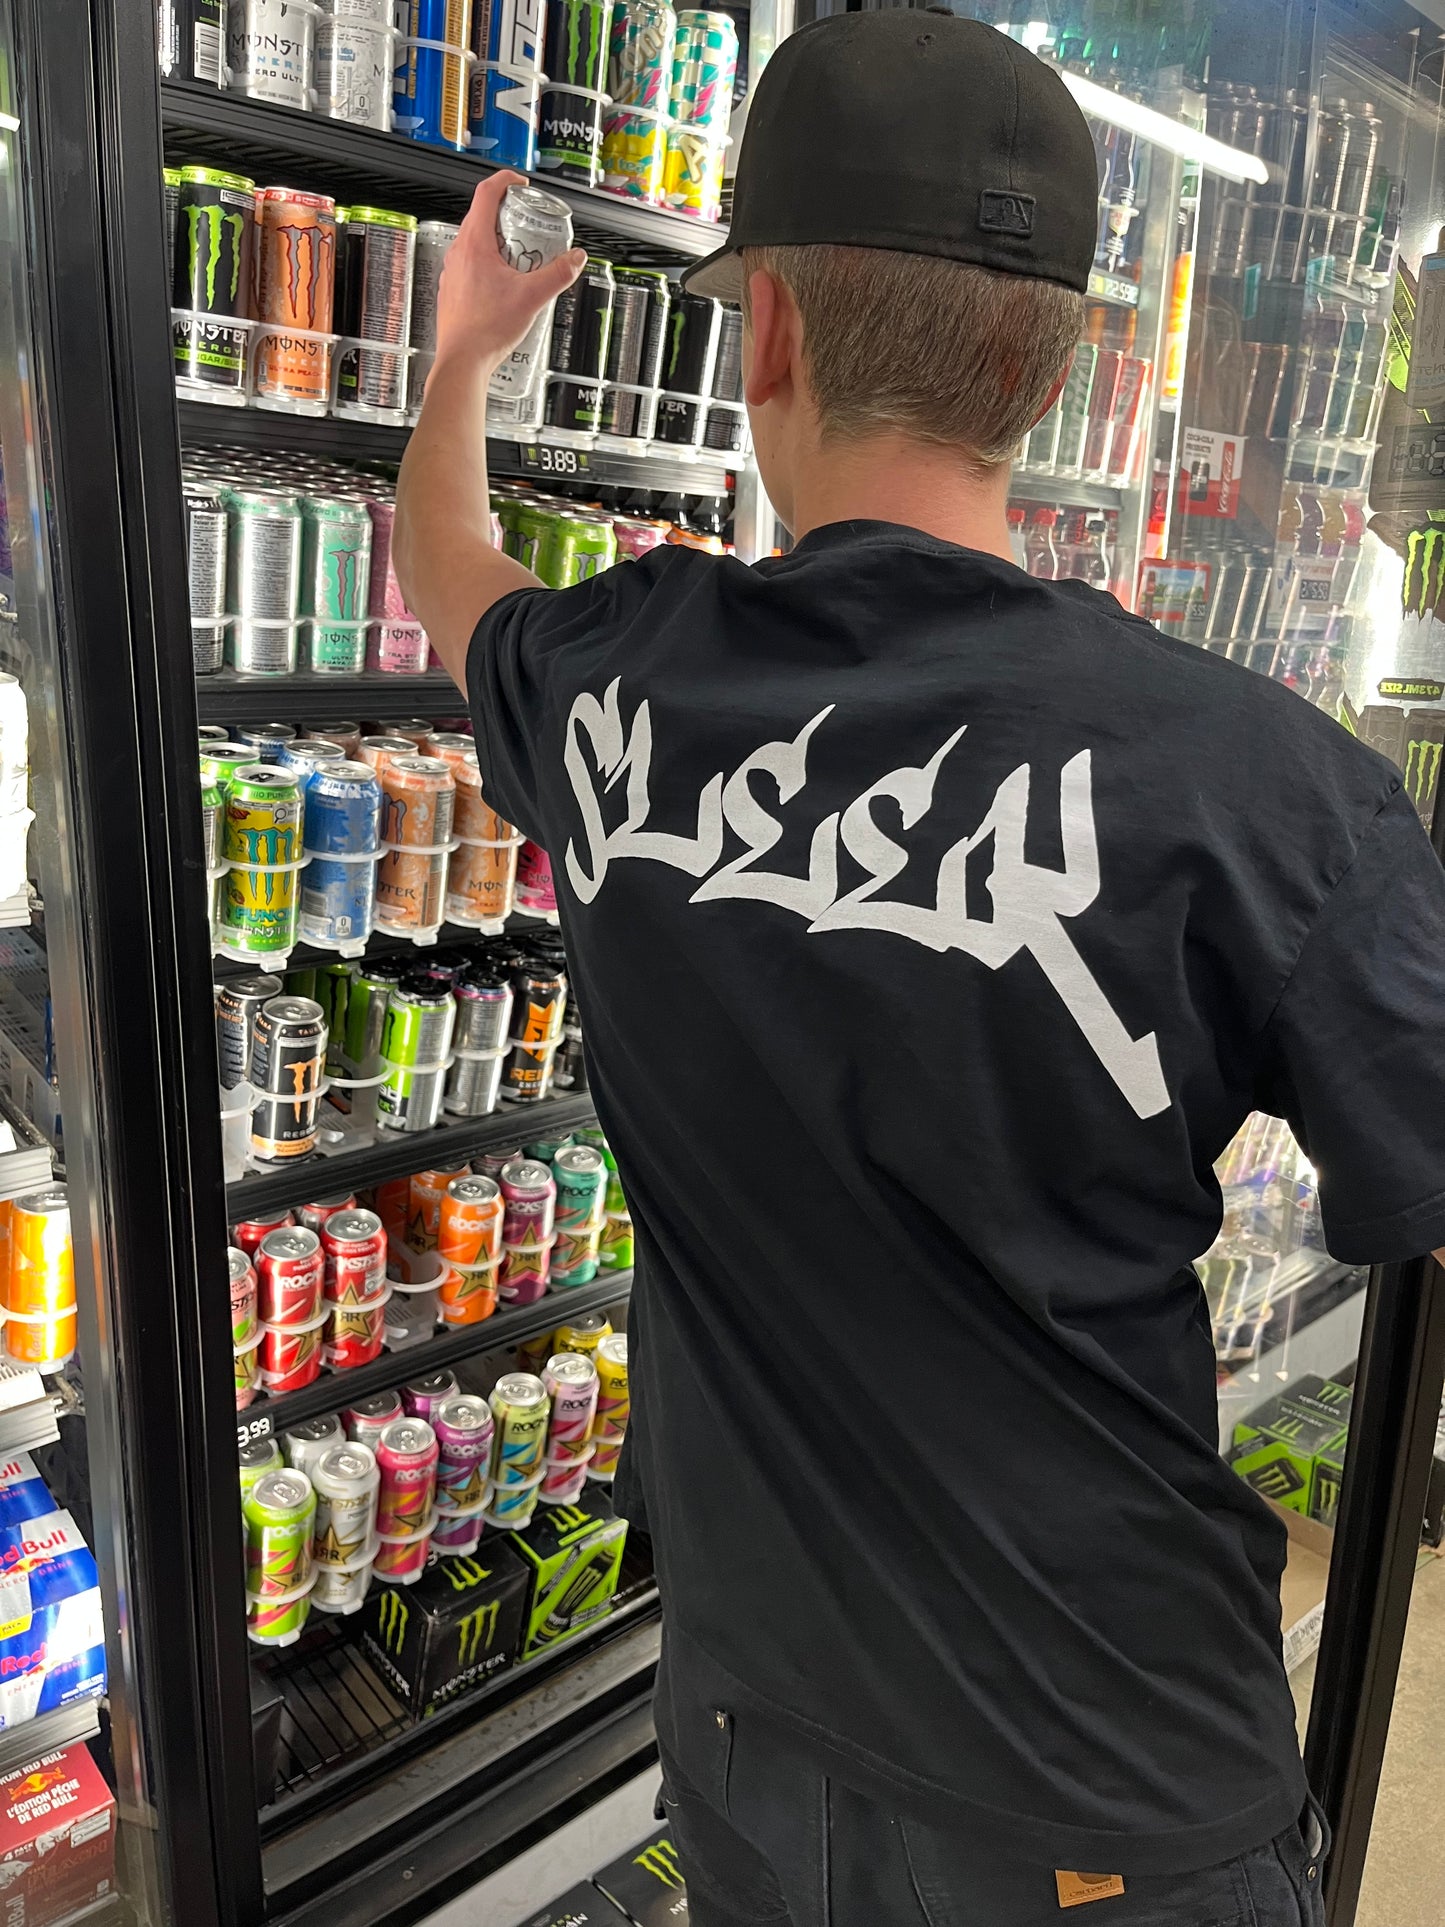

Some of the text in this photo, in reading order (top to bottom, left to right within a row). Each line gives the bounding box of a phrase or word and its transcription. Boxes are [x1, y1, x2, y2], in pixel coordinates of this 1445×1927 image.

[232, 32, 306, 57] MONST
[543, 118, 604, 146] MONS
[540, 447, 578, 474] 3.89
[237, 1416, 271, 1449] 3.99
[21, 1529, 68, 1556] Bull
[0, 1641, 48, 1676] Red
[42, 1750, 68, 1767] BULL.
[17, 1793, 79, 1826] DE RED BULL.
[3, 1849, 14, 1862] 4
